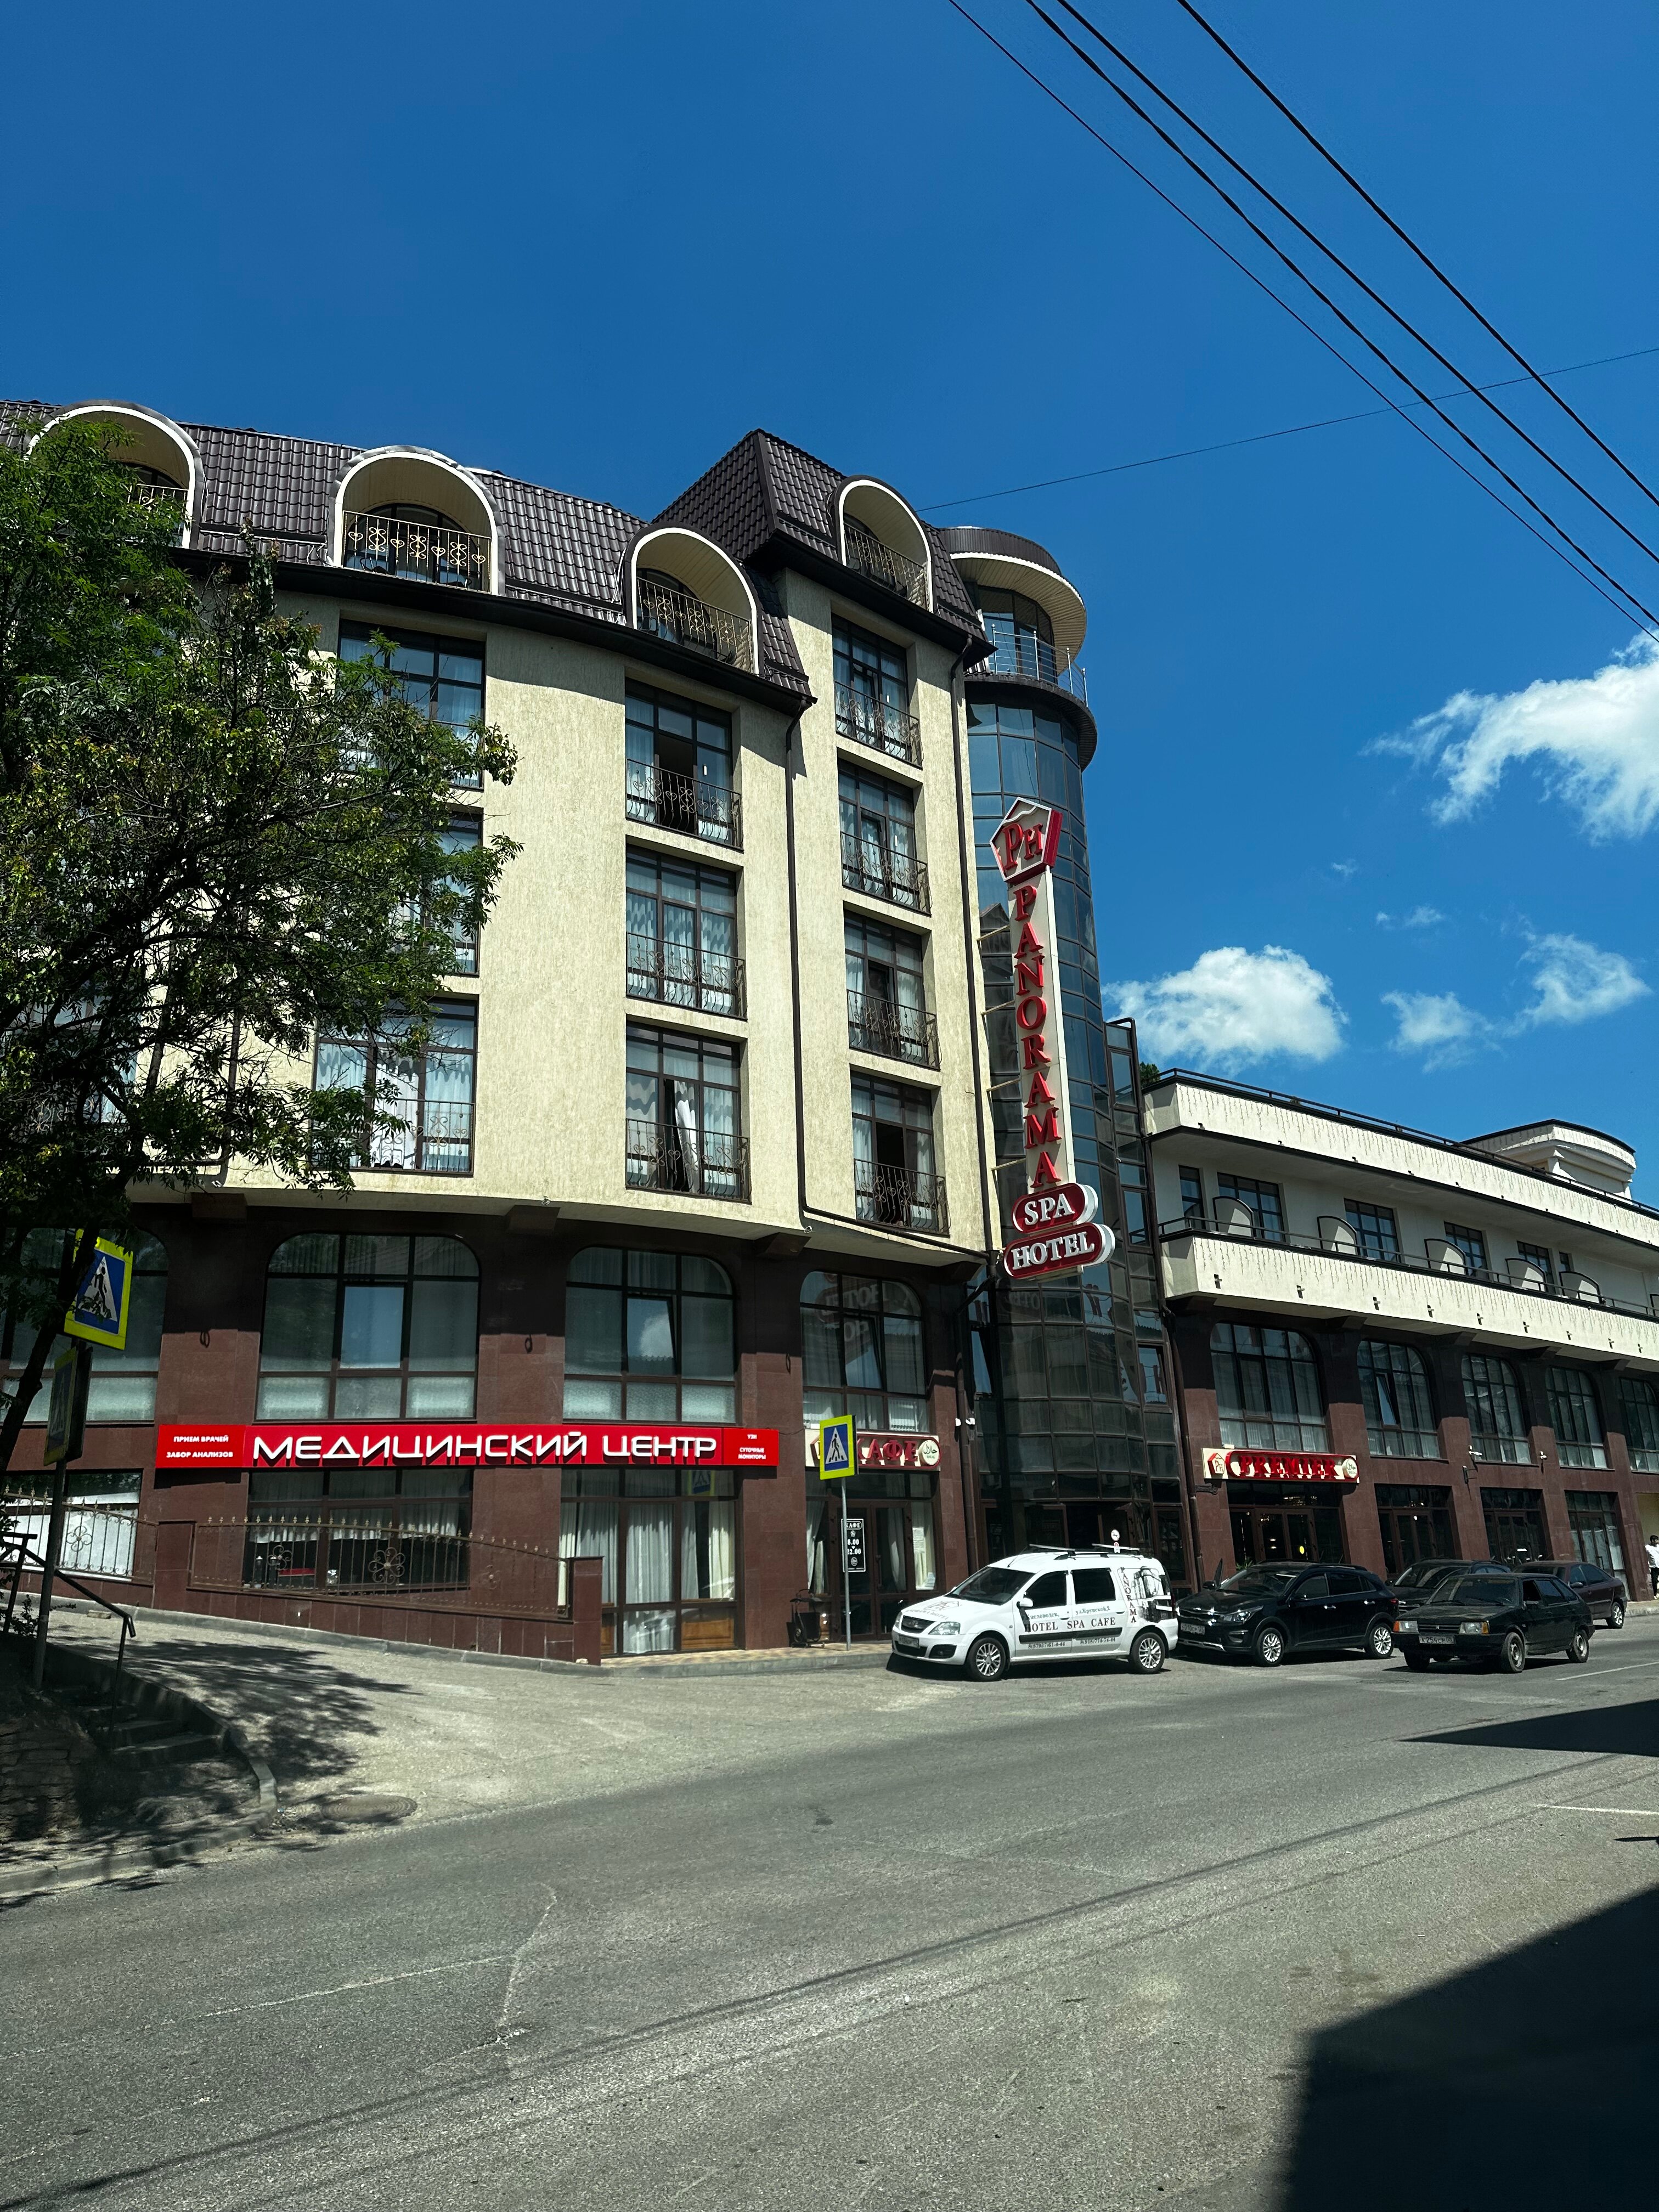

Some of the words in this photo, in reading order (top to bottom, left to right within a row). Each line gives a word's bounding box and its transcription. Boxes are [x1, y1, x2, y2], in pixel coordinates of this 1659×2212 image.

[1013, 885, 1062, 1189] PANORAMA
[1024, 1193, 1075, 1226] SPA
[1011, 1231, 1095, 1270] HOTEL
[253, 1431, 587, 1459] МЕДИЦИНСКИЙ
[602, 1435, 717, 1458] ЦЕНТР
[1239, 1455, 1339, 1476] PREMIER
[1120, 1566, 1137, 1623] PANORAMA
[1025, 1622, 1058, 1633] HOTEL
[1067, 1620, 1085, 1629] SPA
[1091, 1617, 1116, 1627] CAFE
